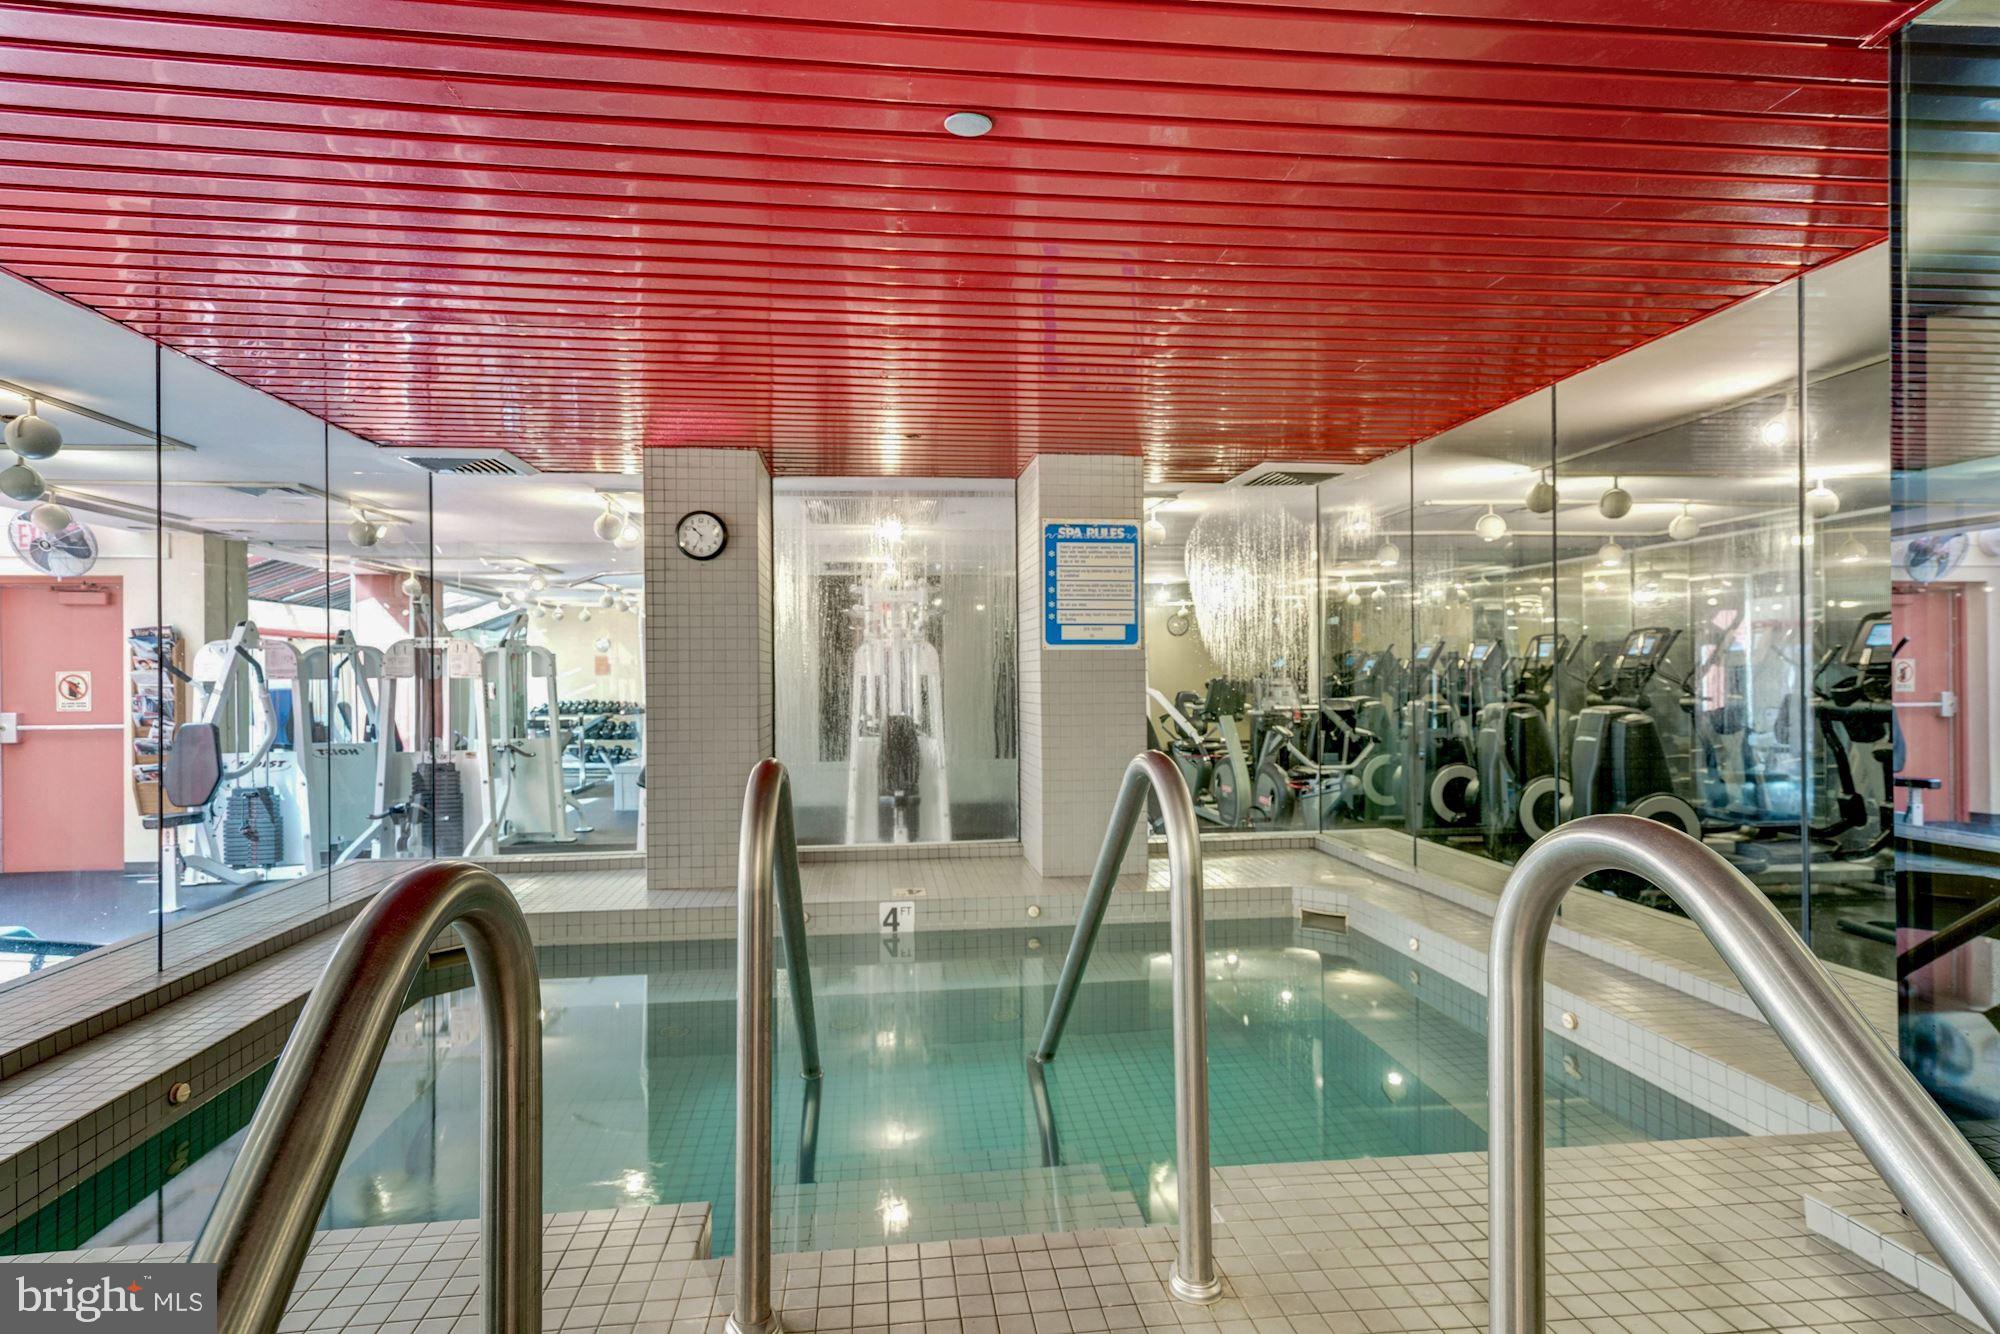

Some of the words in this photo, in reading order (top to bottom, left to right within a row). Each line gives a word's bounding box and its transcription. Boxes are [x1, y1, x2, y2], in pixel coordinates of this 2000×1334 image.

[1057, 527, 1083, 539] SPA
[1086, 527, 1125, 539] RULES
[883, 907, 900, 932] 4
[900, 906, 912, 916] FT
